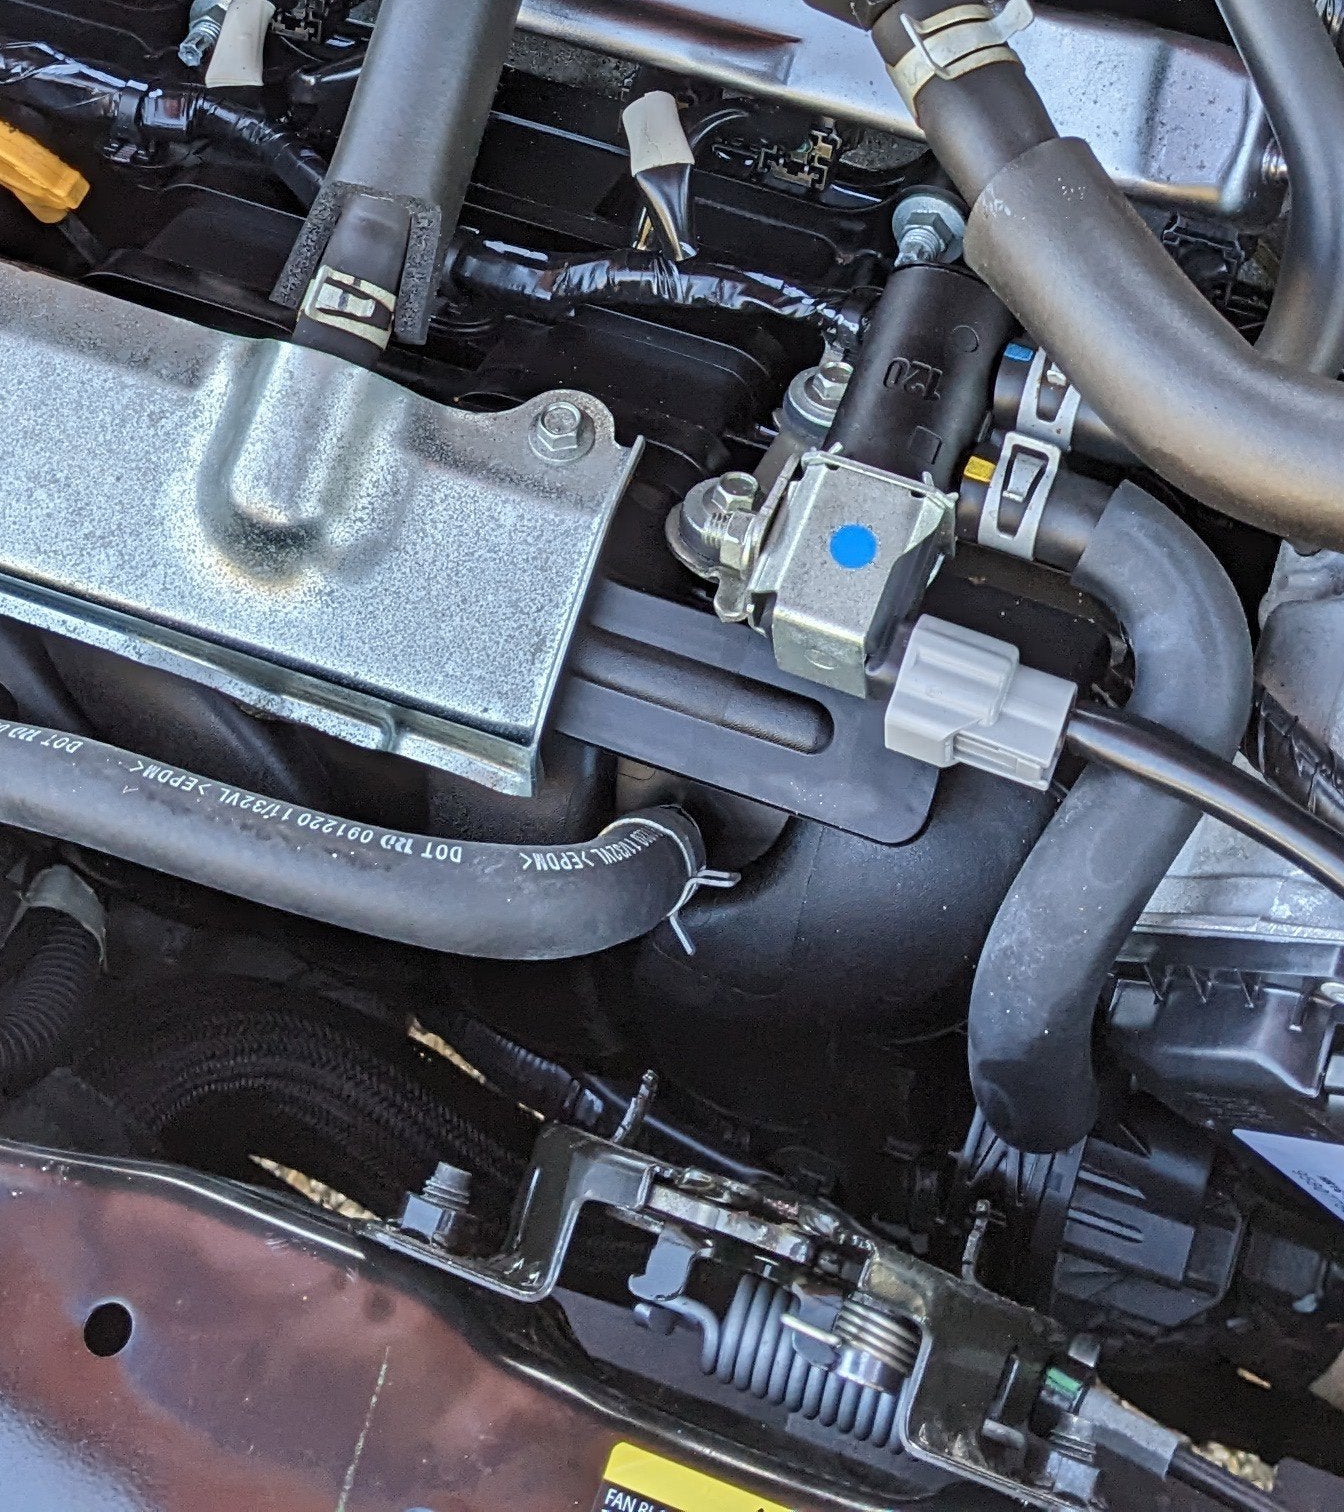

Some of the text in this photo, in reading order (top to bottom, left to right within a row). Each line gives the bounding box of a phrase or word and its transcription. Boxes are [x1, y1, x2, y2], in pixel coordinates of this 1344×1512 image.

[41, 734, 83, 753] DOT
[298, 813, 373, 843] 091220
[421, 842, 462, 863] DOT
[605, 1489, 637, 1512] FAN
